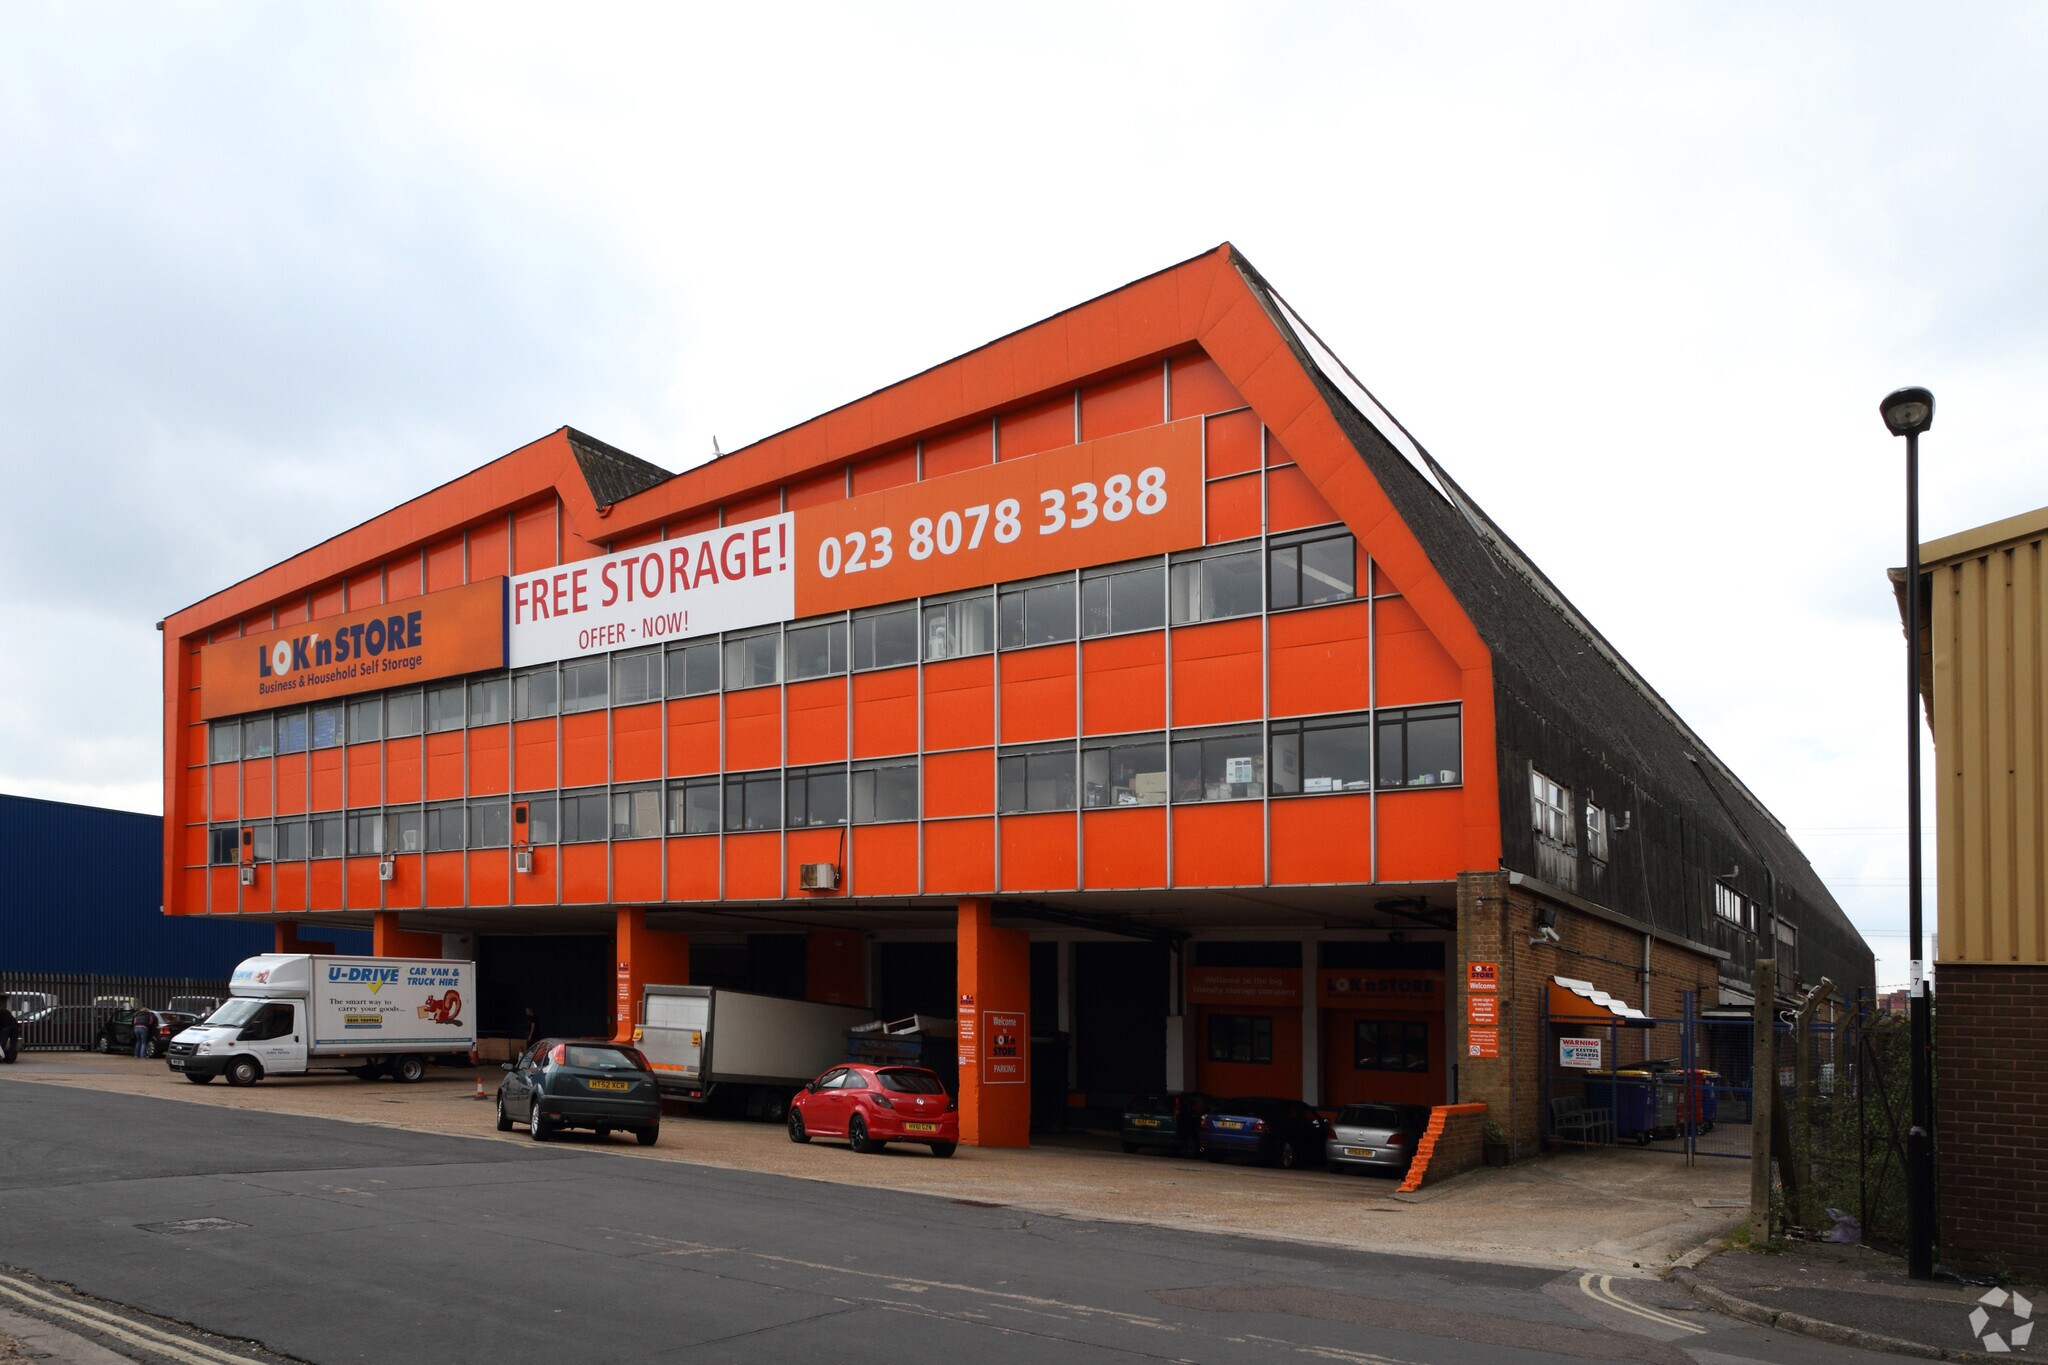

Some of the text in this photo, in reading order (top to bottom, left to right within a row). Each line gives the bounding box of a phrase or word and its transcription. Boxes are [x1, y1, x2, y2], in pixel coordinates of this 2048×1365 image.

[818, 466, 1167, 578] 023 8078 3388
[515, 523, 787, 625] FREE STORAGE!
[579, 622, 626, 650] OFFER
[642, 610, 688, 638] NOW!
[259, 655, 423, 695] Business & Household Self Storage
[328, 967, 399, 982] U-DRIVE
[409, 967, 460, 976] CAR VAN &
[407, 977, 459, 986] TRUCK HIRE
[1204, 976, 1240, 984] Welcome
[1269, 977, 1283, 986] big
[1192, 985, 1297, 997] friendly storage company
[993, 1016, 1016, 1026] Welcome
[993, 1046, 1016, 1056] STORE
[993, 1065, 1016, 1073] PARKING
